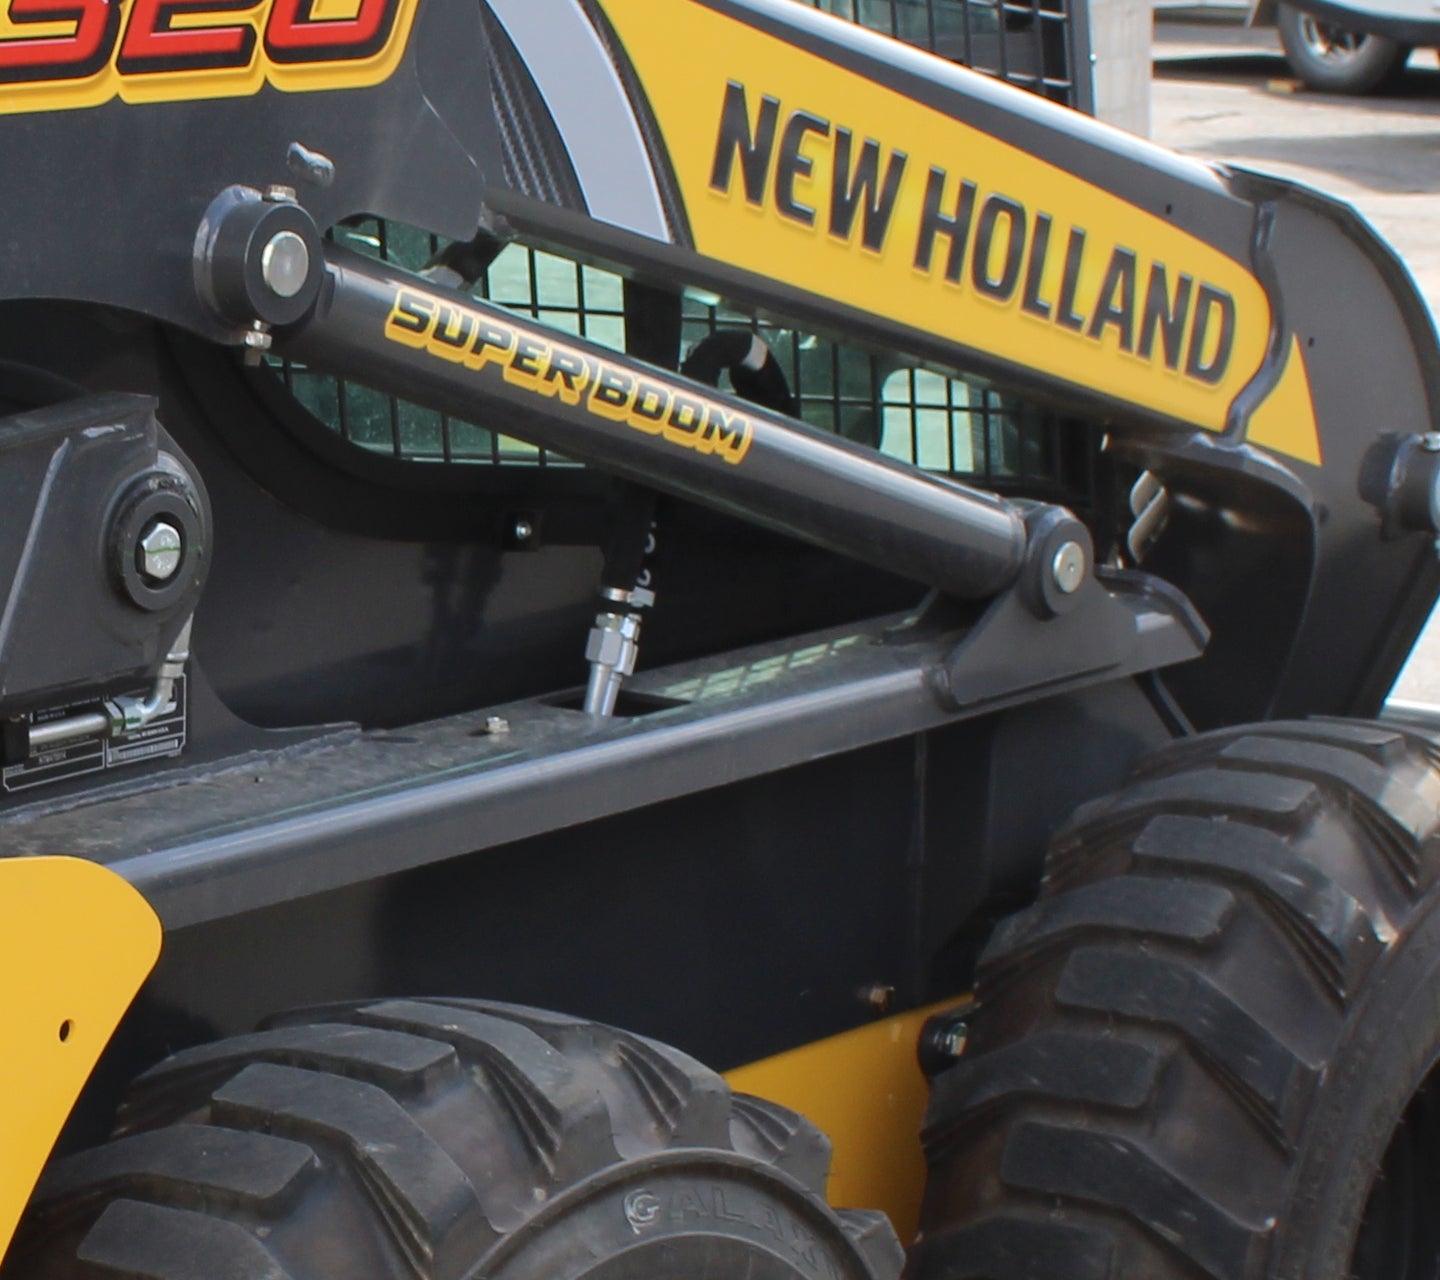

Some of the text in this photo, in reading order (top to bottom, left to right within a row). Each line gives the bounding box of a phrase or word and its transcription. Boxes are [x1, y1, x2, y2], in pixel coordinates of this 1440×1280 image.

[708, 78, 1238, 387] NEW HOLLAND
[385, 288, 754, 464] SUPER BOOM
